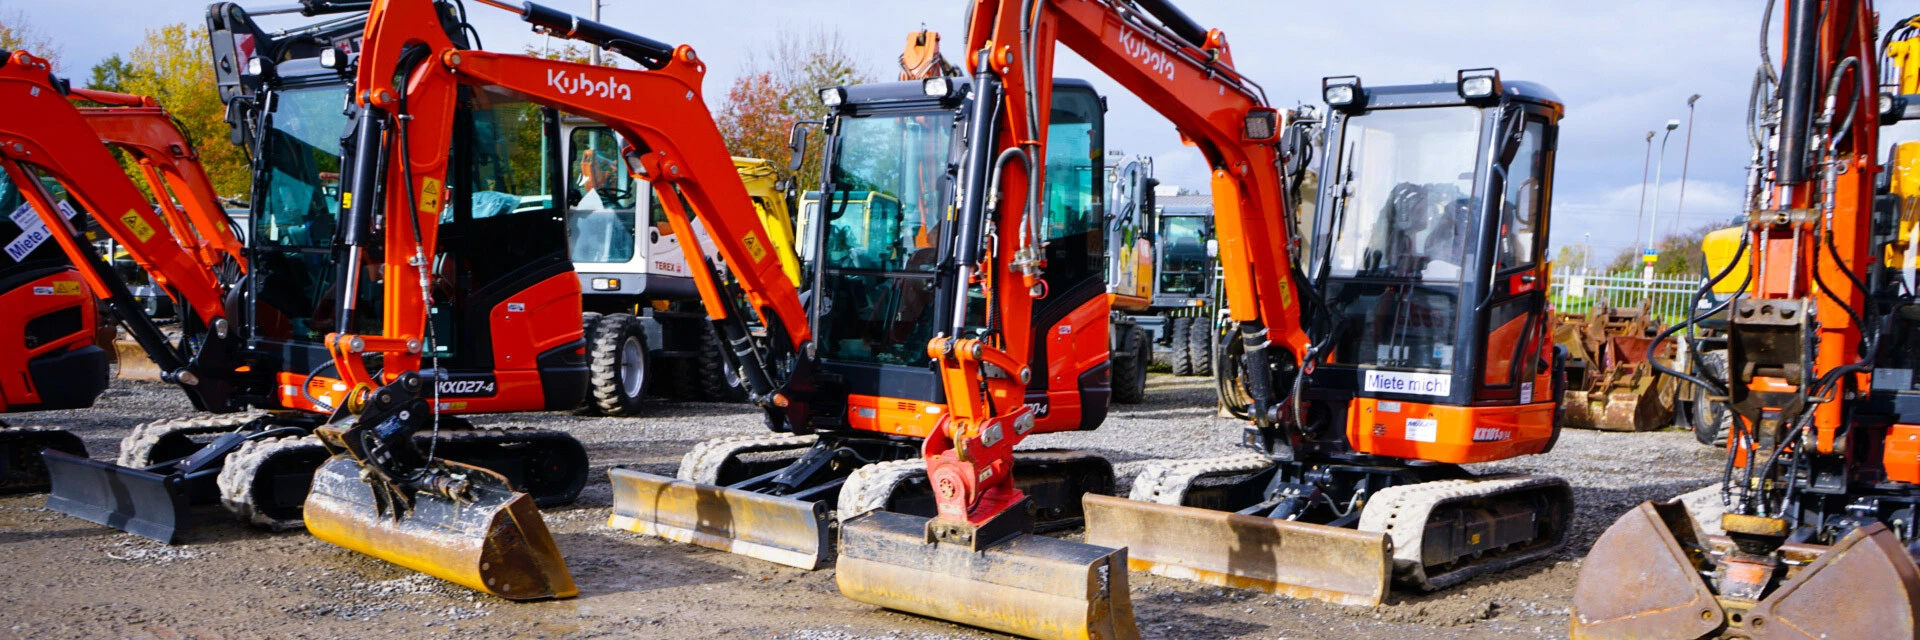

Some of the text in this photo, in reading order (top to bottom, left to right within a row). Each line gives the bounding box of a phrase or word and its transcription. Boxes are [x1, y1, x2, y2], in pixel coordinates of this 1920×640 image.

[1119, 24, 1175, 81] Kubota
[547, 68, 631, 101] Kubota
[8, 231, 43, 259] Miete
[655, 261, 675, 272] TEREX
[439, 381, 494, 393] KX027-4
[1368, 374, 1448, 392] Miete mich!
